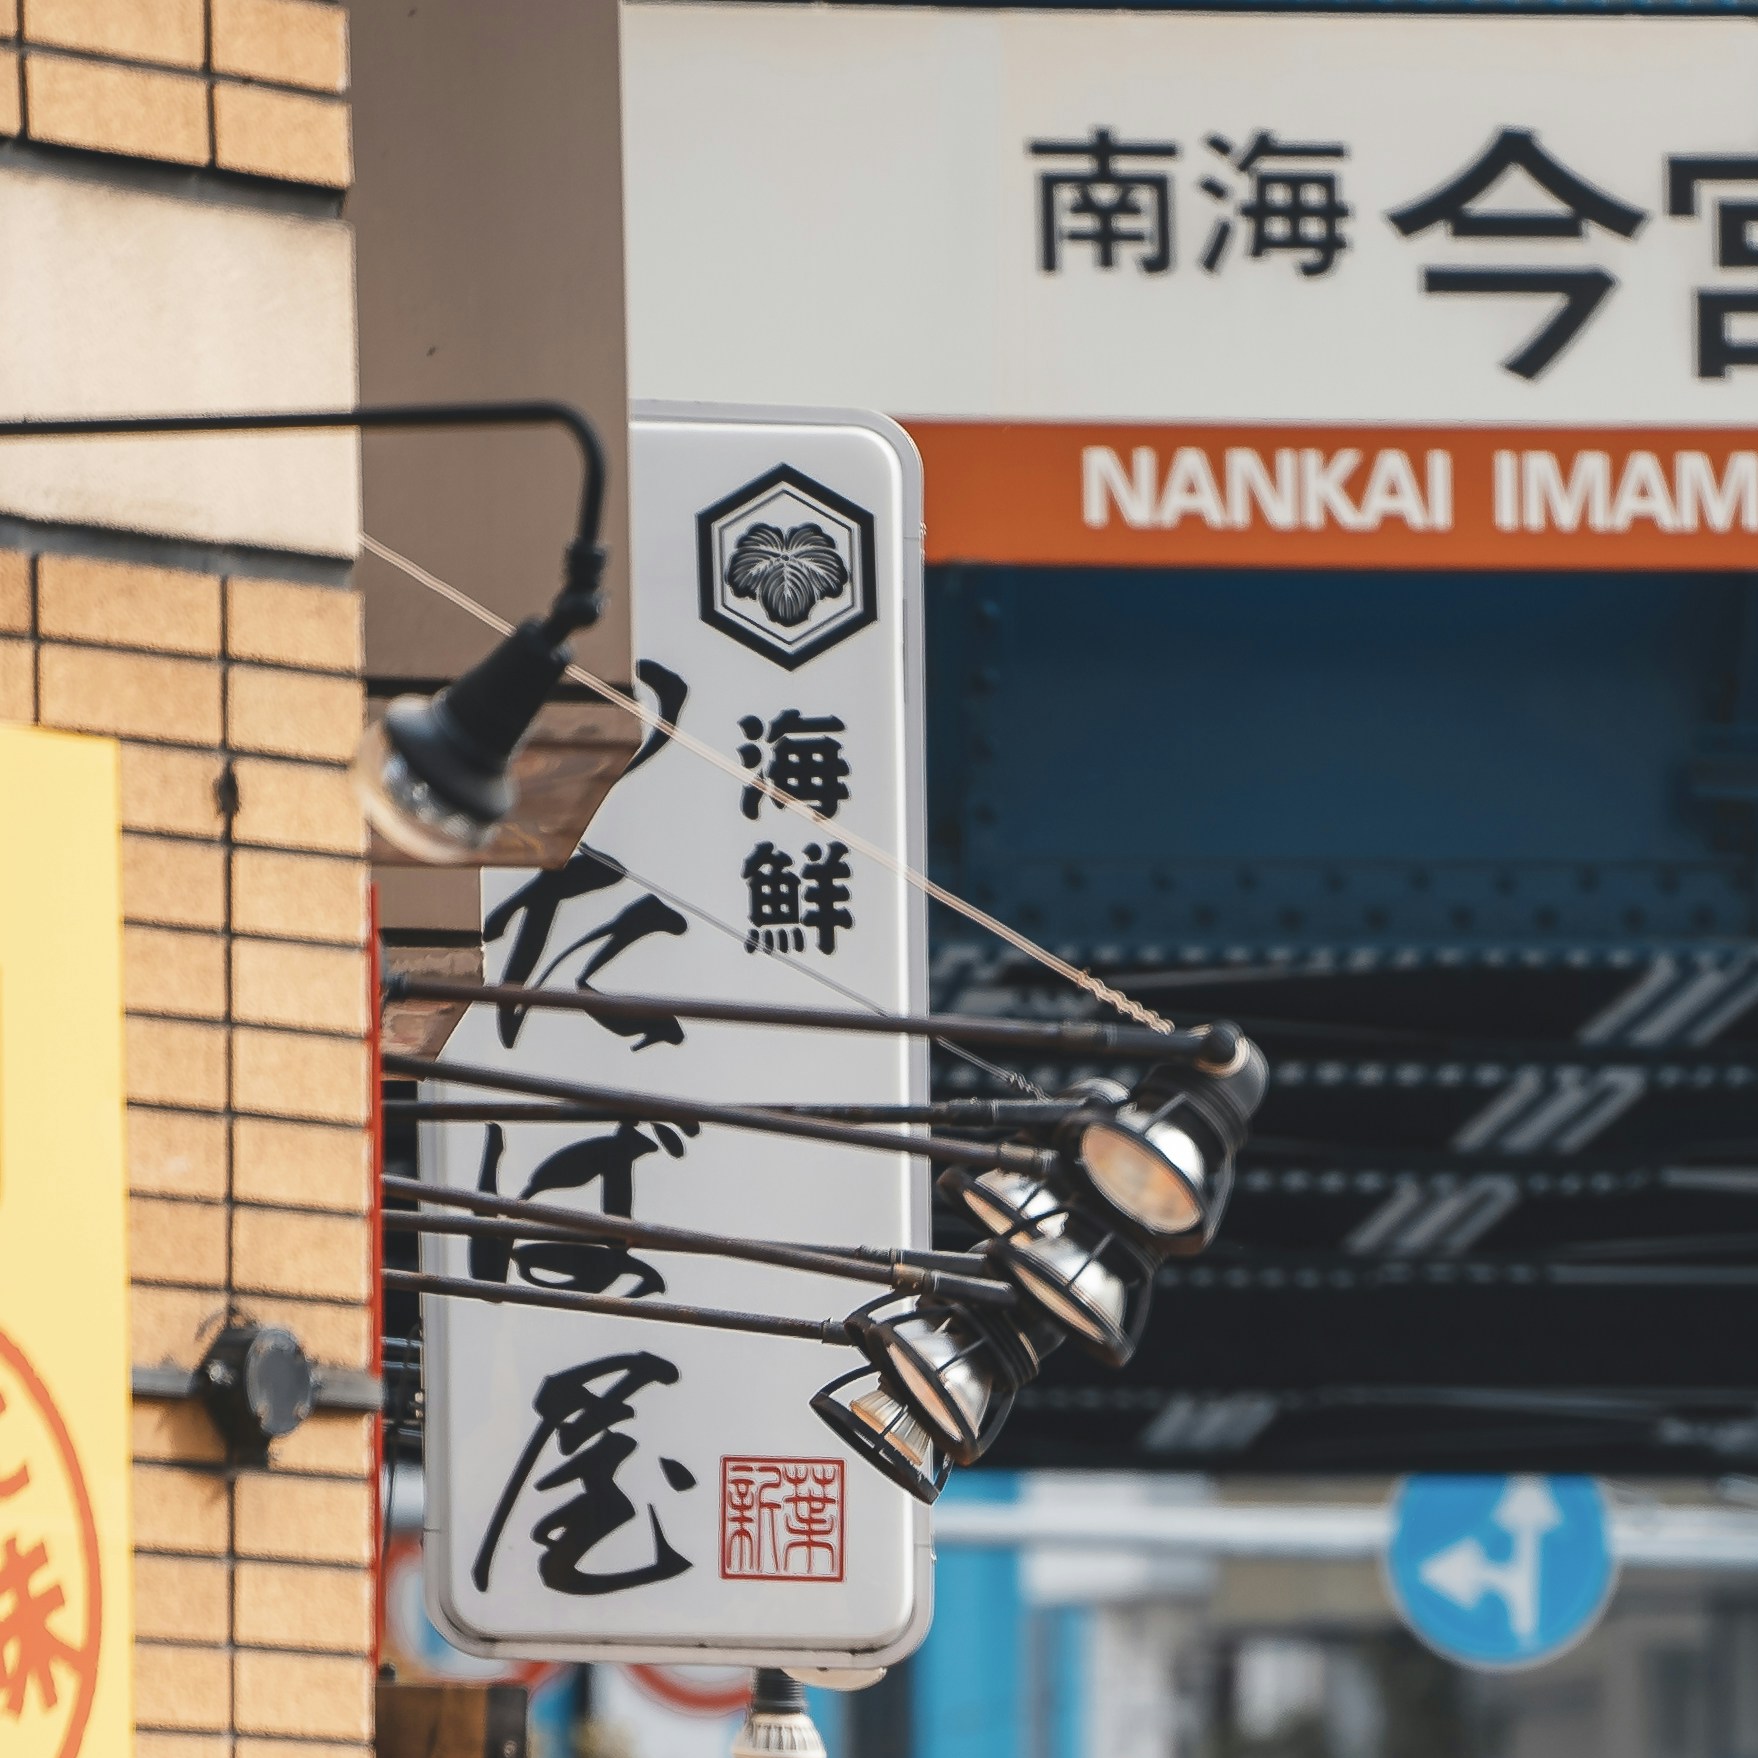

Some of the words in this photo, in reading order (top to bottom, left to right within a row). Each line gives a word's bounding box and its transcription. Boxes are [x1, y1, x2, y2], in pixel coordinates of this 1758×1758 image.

[1028, 128, 1348, 277] 南海
[1082, 447, 1453, 529] NANKAI
[736, 707, 854, 956] 海鮮
